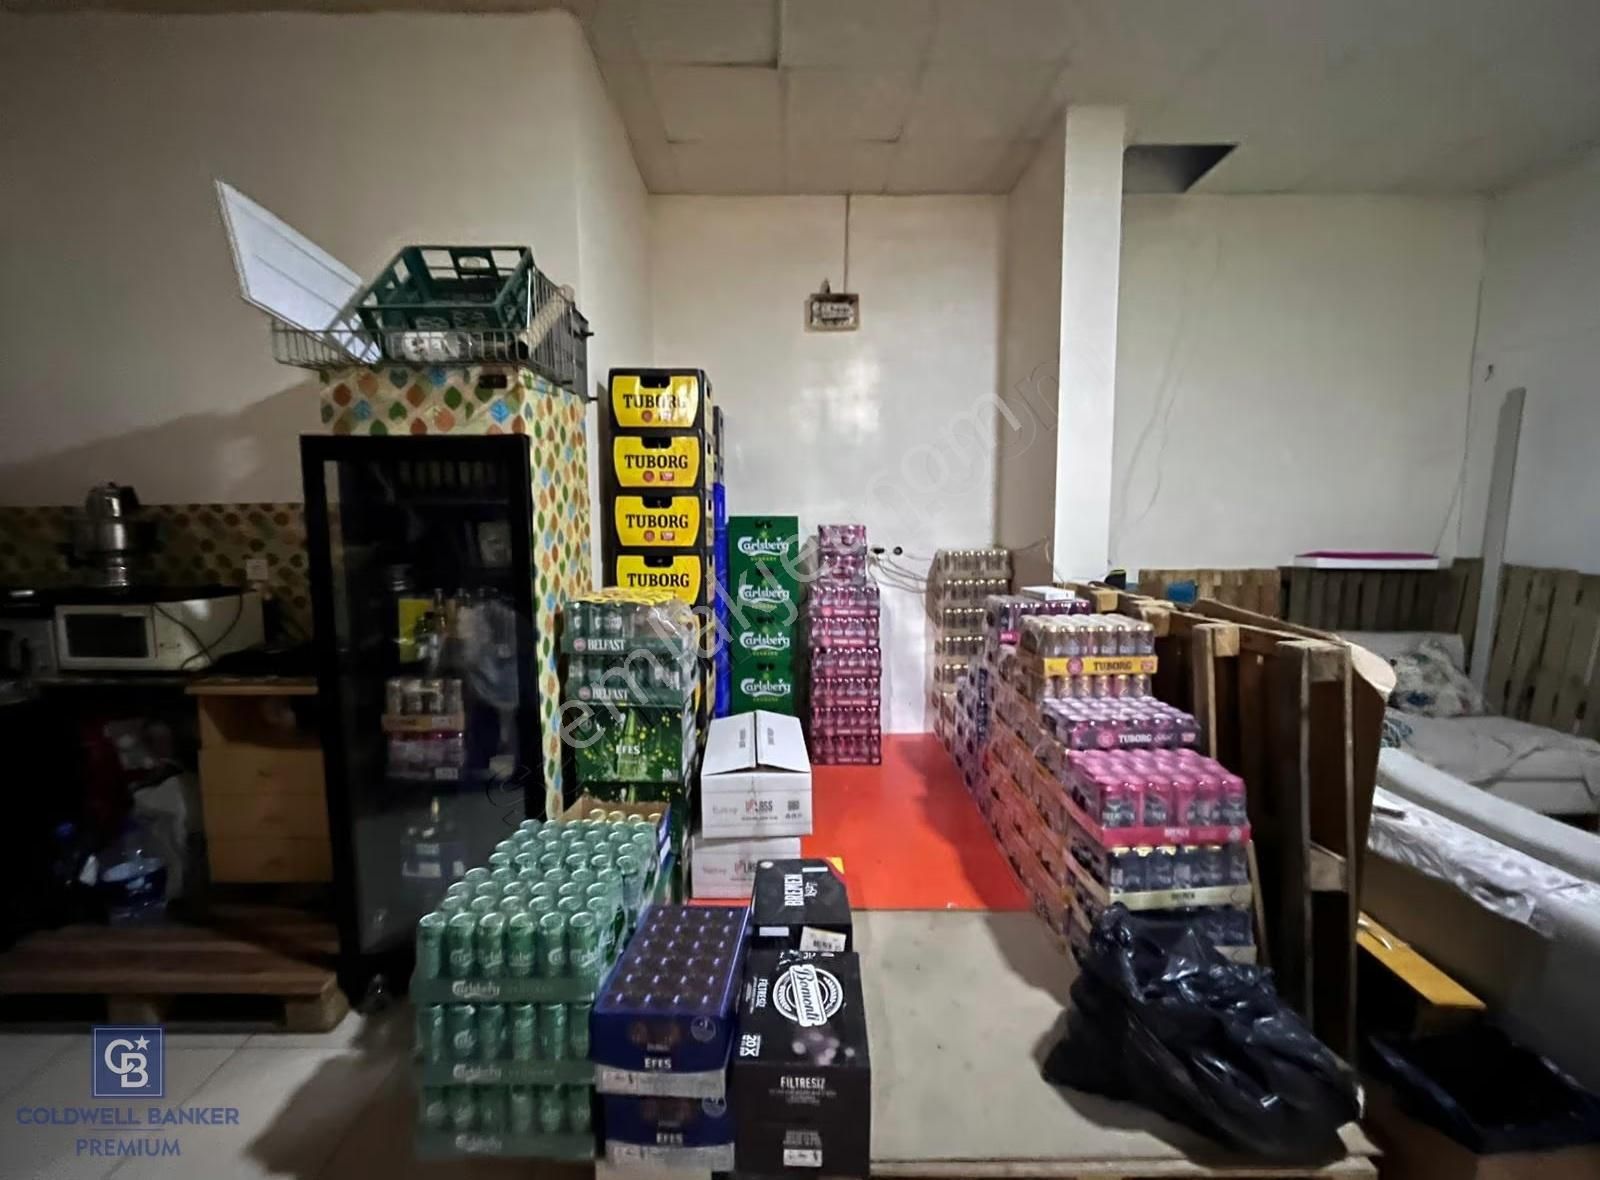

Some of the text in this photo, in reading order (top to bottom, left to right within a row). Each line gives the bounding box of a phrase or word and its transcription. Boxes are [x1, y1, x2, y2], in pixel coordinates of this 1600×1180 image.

[623, 394, 685, 409] TUBORG
[624, 454, 688, 469] TUBORG
[625, 514, 688, 529] TUBORG
[737, 535, 790, 556] Carlsberg
[627, 573, 689, 588] TUBORG
[738, 583, 790, 604] Carlsberg
[587, 639, 625, 651] BELFAST
[739, 631, 790, 651] Carlsberg
[1093, 661, 1132, 671] TUBORG
[591, 687, 628, 699] BELFAST
[740, 677, 791, 697] Carlsberg
[1118, 733, 1152, 744] TUBORG
[615, 744, 640, 755] EFES
[784, 873, 804, 906] BREMEN
[792, 968, 821, 1022] Bomonti
[744, 1034, 757, 1057] 20X
[644, 1057, 672, 1069] EFES
